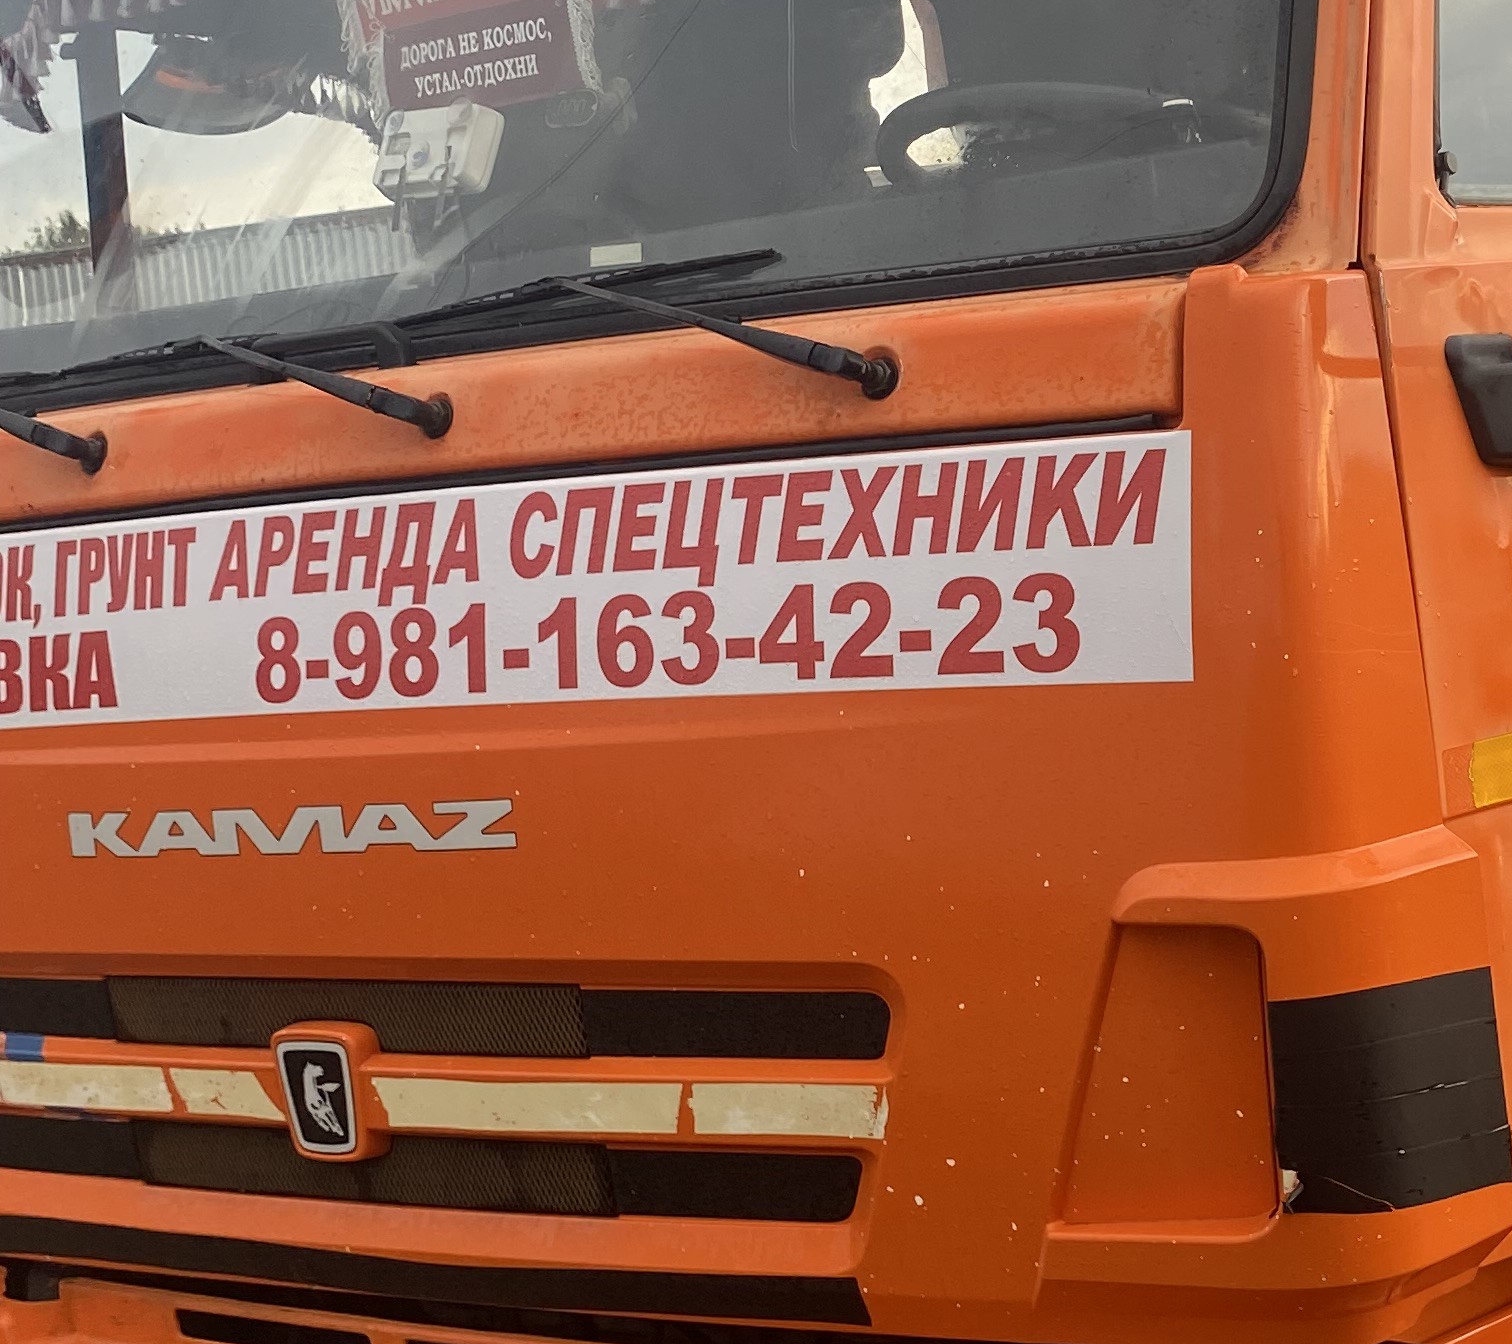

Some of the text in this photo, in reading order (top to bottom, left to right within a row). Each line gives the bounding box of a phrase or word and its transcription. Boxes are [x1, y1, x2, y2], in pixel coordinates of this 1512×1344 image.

[400, 17, 553, 72] ДОРОГА НЕ КОСМОС,
[414, 53, 540, 99] УСТАЛ-ОТДОХНИ
[0, 448, 1168, 630] К, ГРУНТ АРЕНДА СПЕЦТЕХНИКИ
[255, 572, 1082, 705] 8-981-163-42-23
[67, 797, 518, 859] KAMAZ
